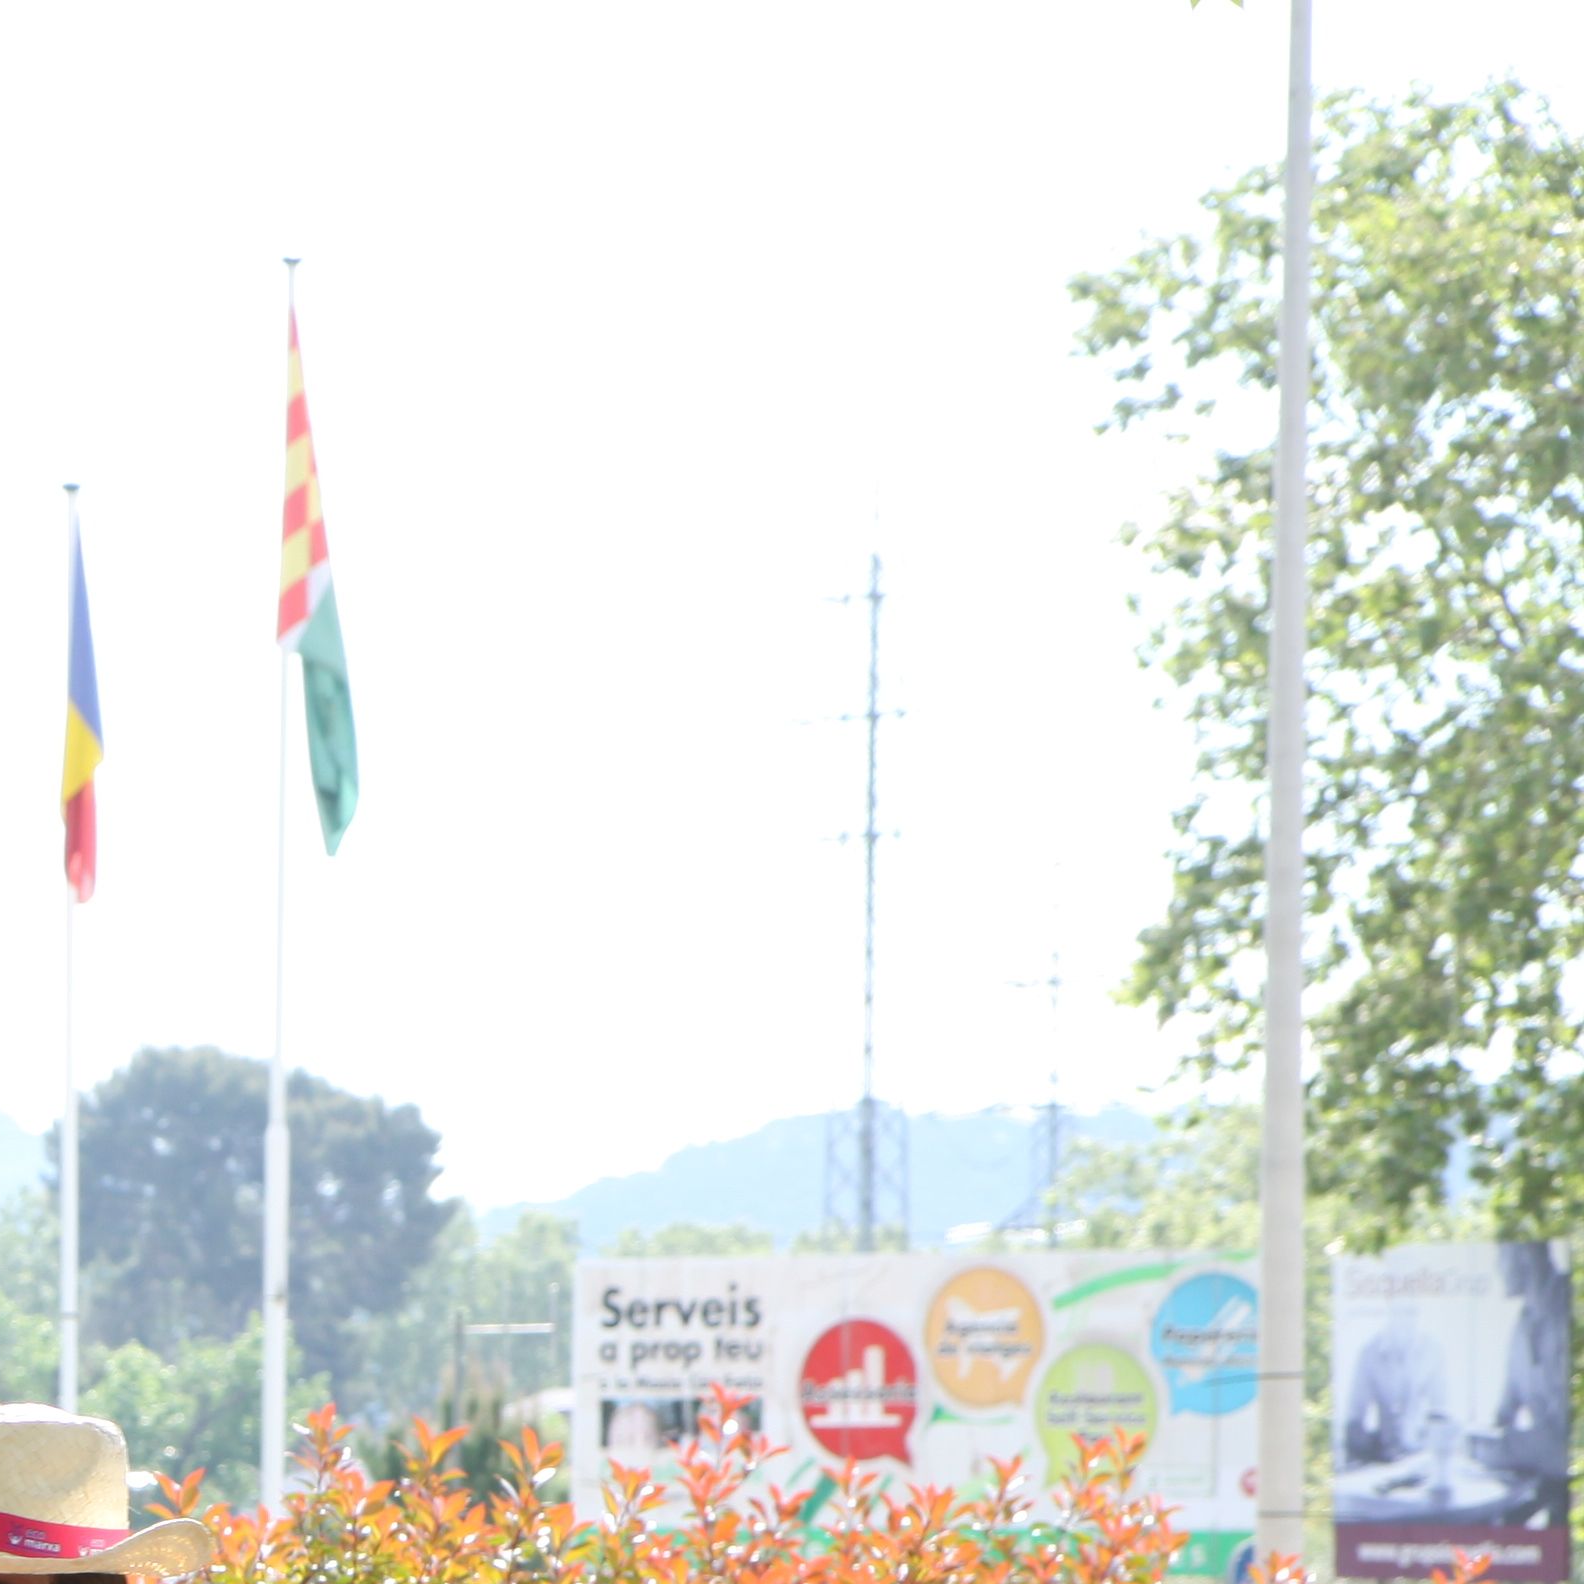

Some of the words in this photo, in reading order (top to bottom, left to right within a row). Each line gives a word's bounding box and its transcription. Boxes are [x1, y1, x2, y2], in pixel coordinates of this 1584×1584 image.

[601, 1281, 761, 1328] Serveis
[599, 1341, 618, 1361] a
[630, 1341, 702, 1370] prop
